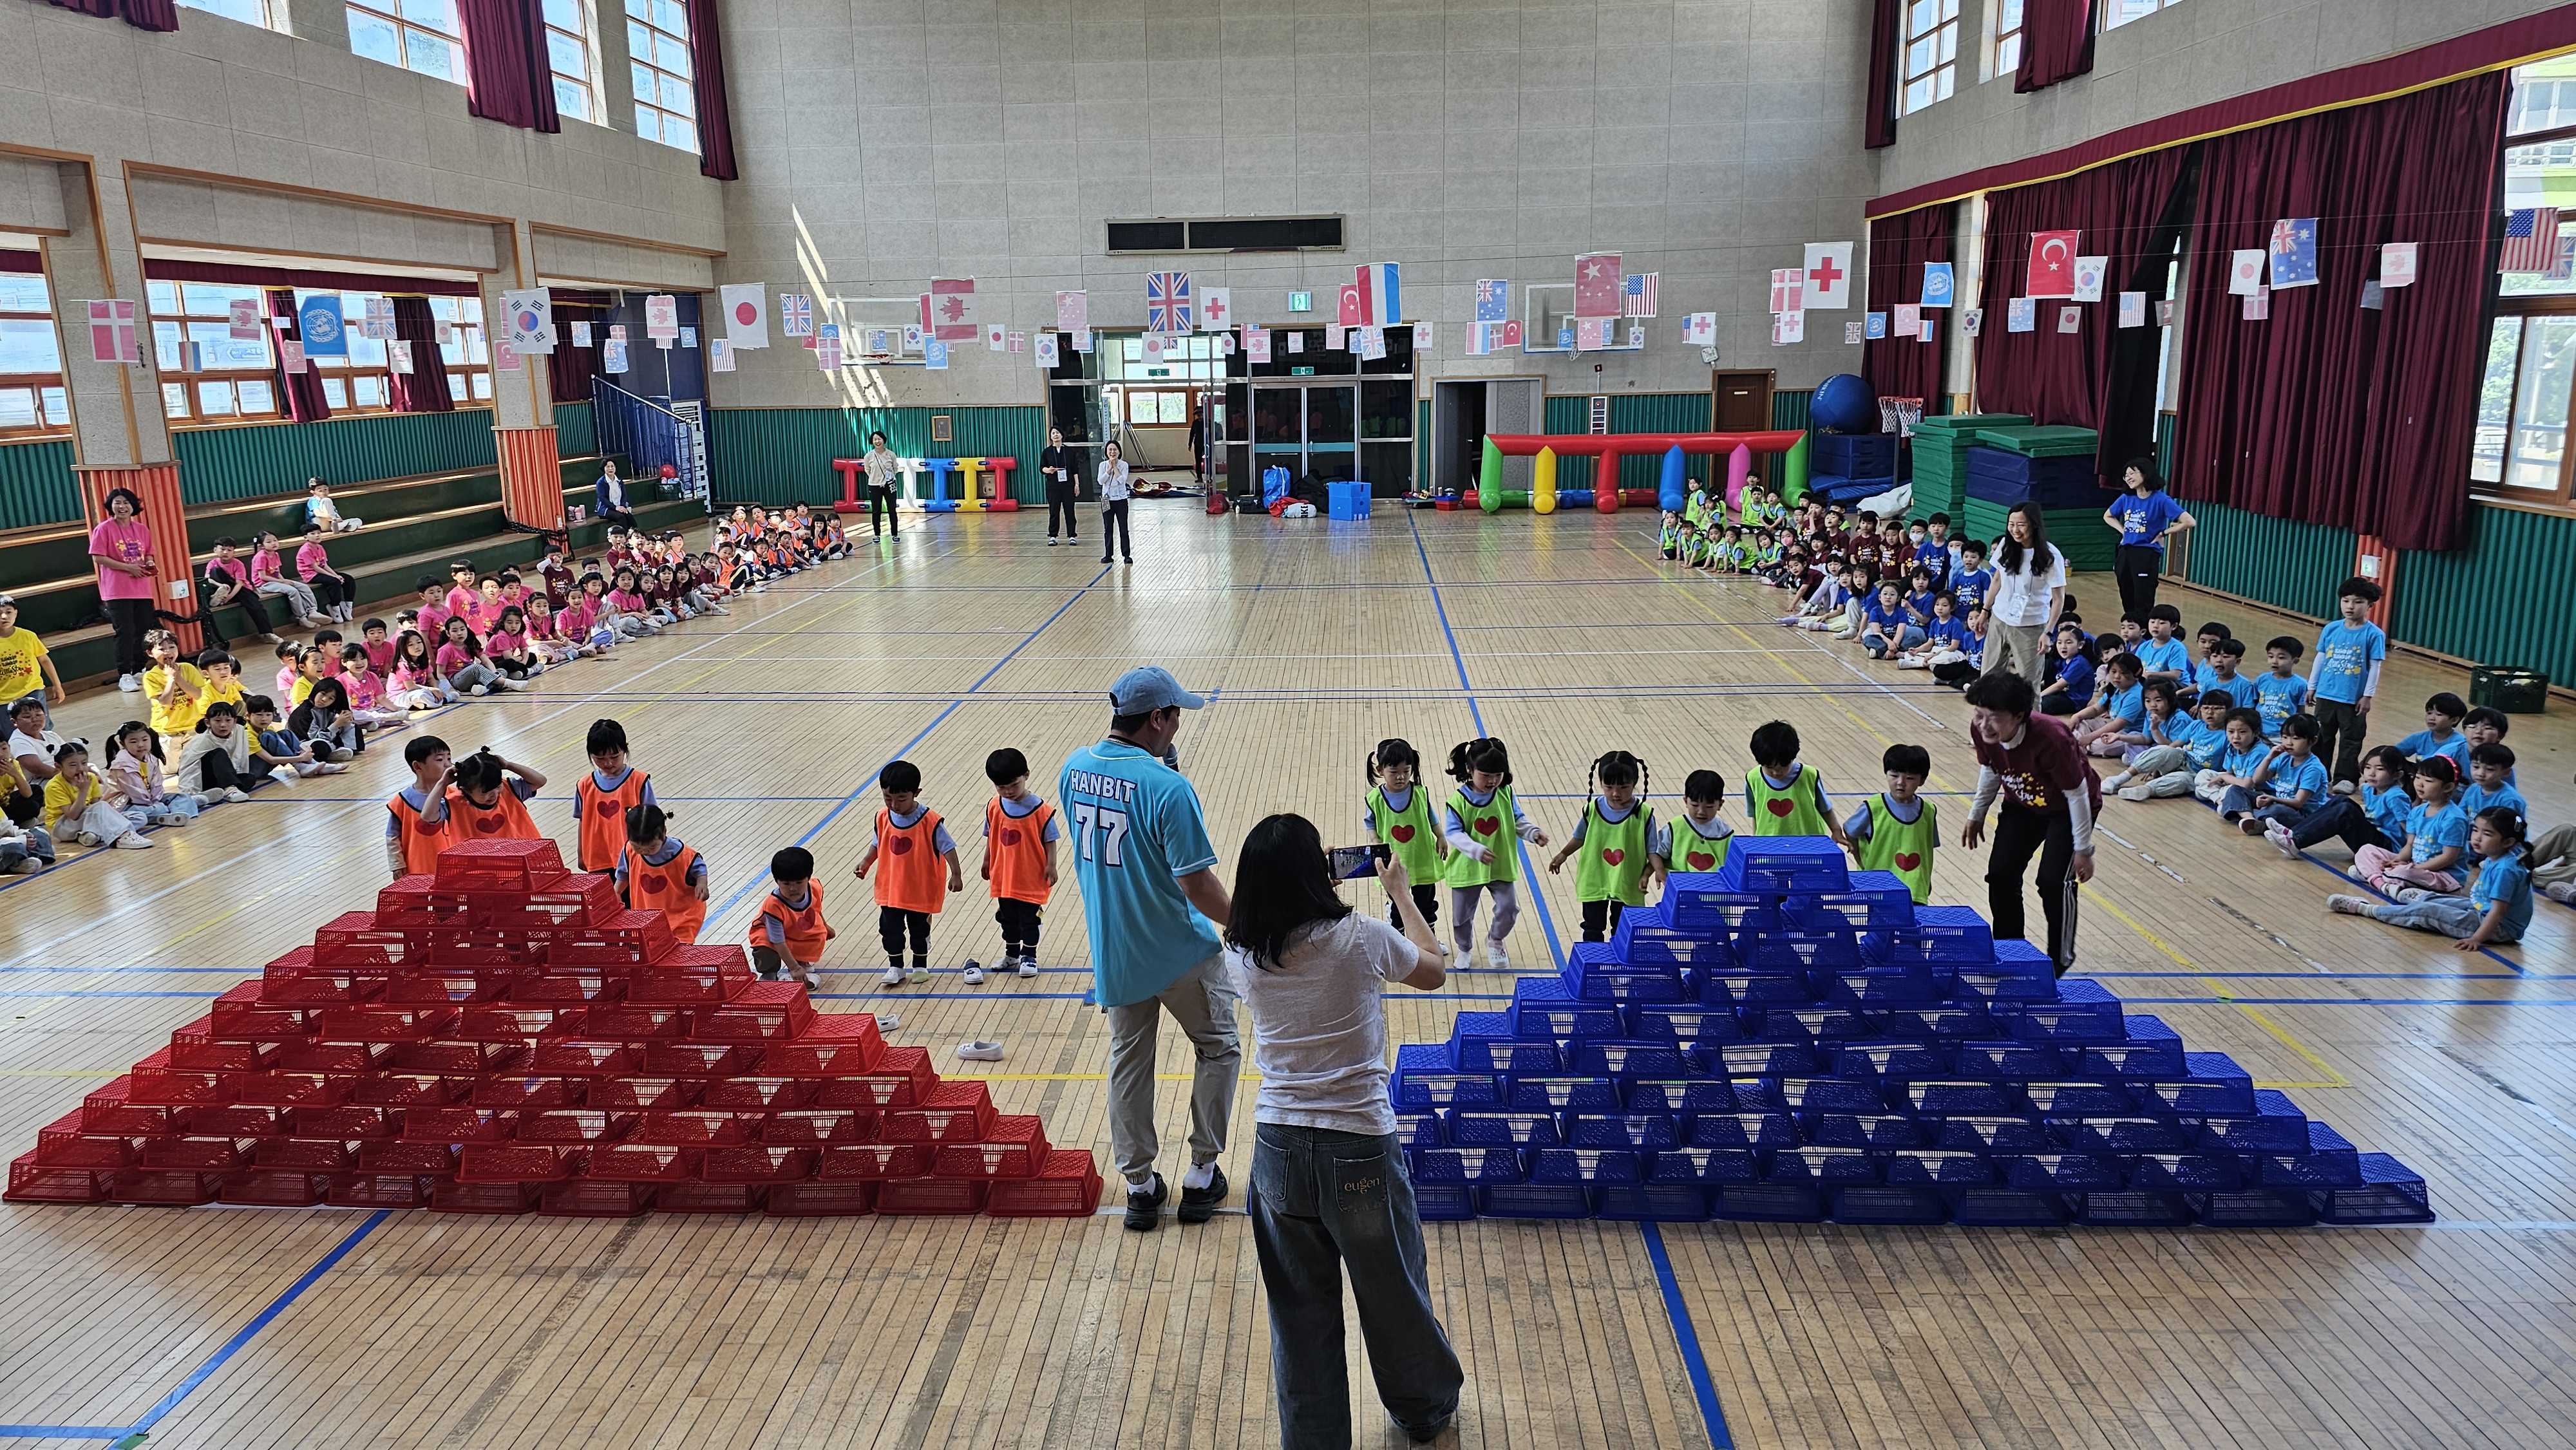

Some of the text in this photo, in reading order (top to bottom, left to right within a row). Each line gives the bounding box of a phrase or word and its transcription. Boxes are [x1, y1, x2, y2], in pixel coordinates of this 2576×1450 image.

[1070, 769, 1137, 804] HANBIT
[1074, 801, 1129, 867] 77
[1344, 1178, 1380, 1194] eugen
